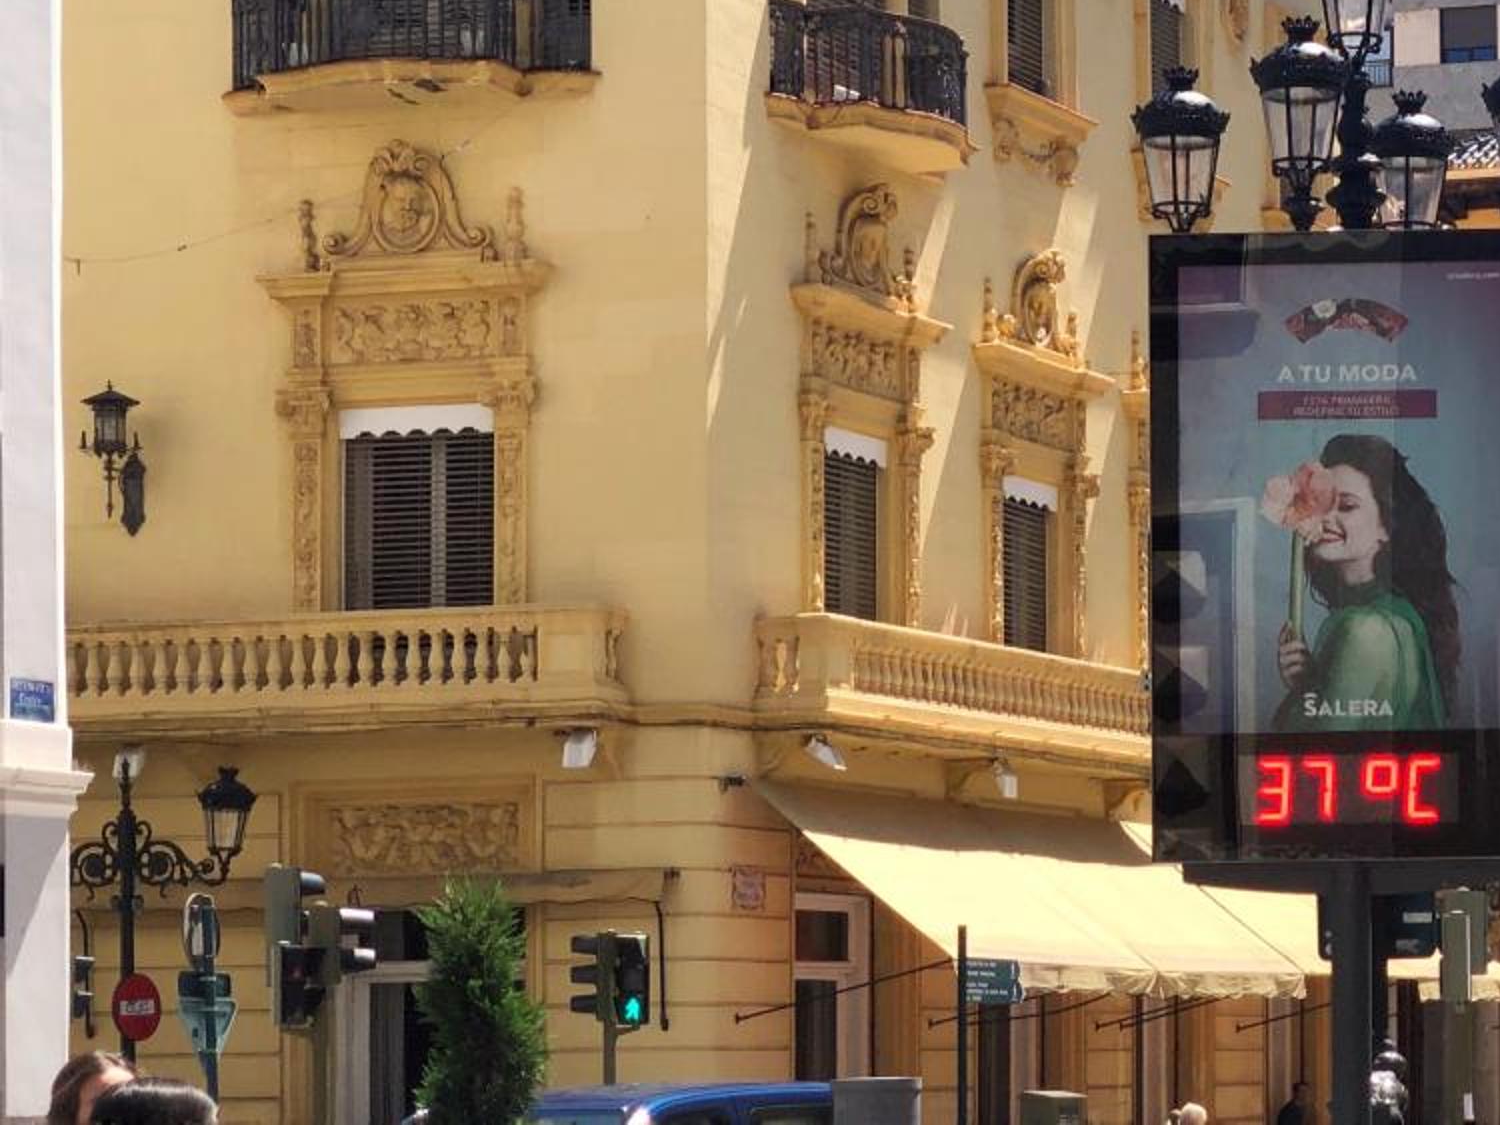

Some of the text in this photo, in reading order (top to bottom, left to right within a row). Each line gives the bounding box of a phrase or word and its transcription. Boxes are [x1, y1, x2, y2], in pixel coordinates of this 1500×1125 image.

[1278, 363, 1417, 382] A TU MODA
[1303, 693, 1393, 716] SALERA
[1255, 754, 1338, 826] 37
